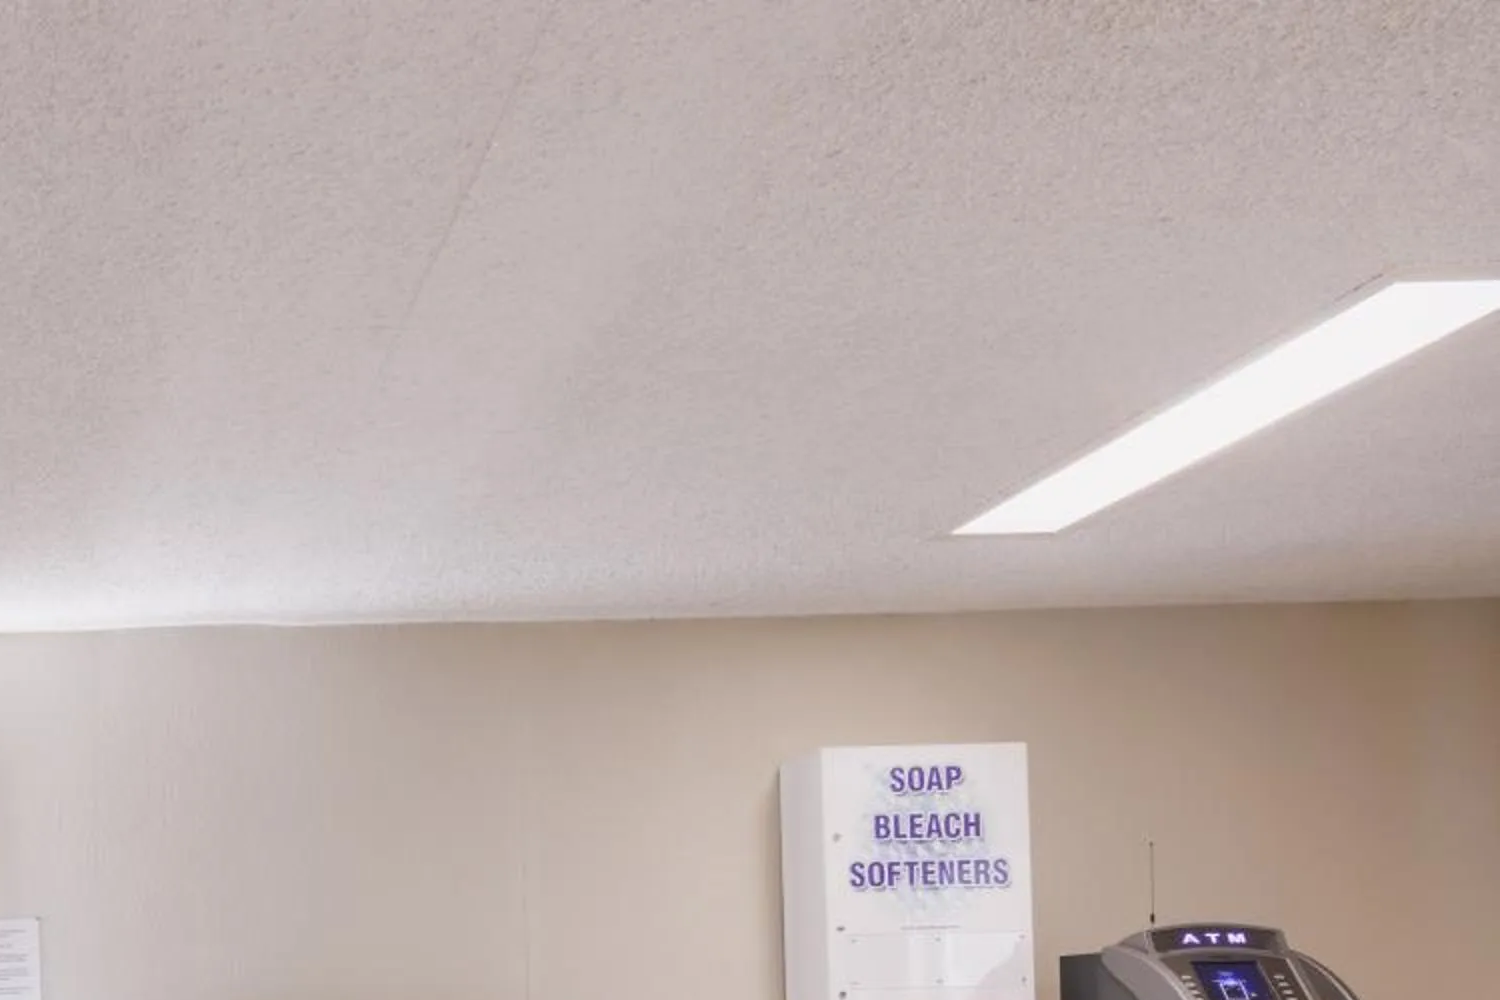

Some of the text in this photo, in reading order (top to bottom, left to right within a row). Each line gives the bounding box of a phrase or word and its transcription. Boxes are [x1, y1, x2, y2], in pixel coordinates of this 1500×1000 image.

[889, 765, 963, 793] SOAP
[874, 812, 982, 840] BLEACH
[849, 858, 1010, 888] SOFTENERS
[1182, 932, 1247, 945] ATM
